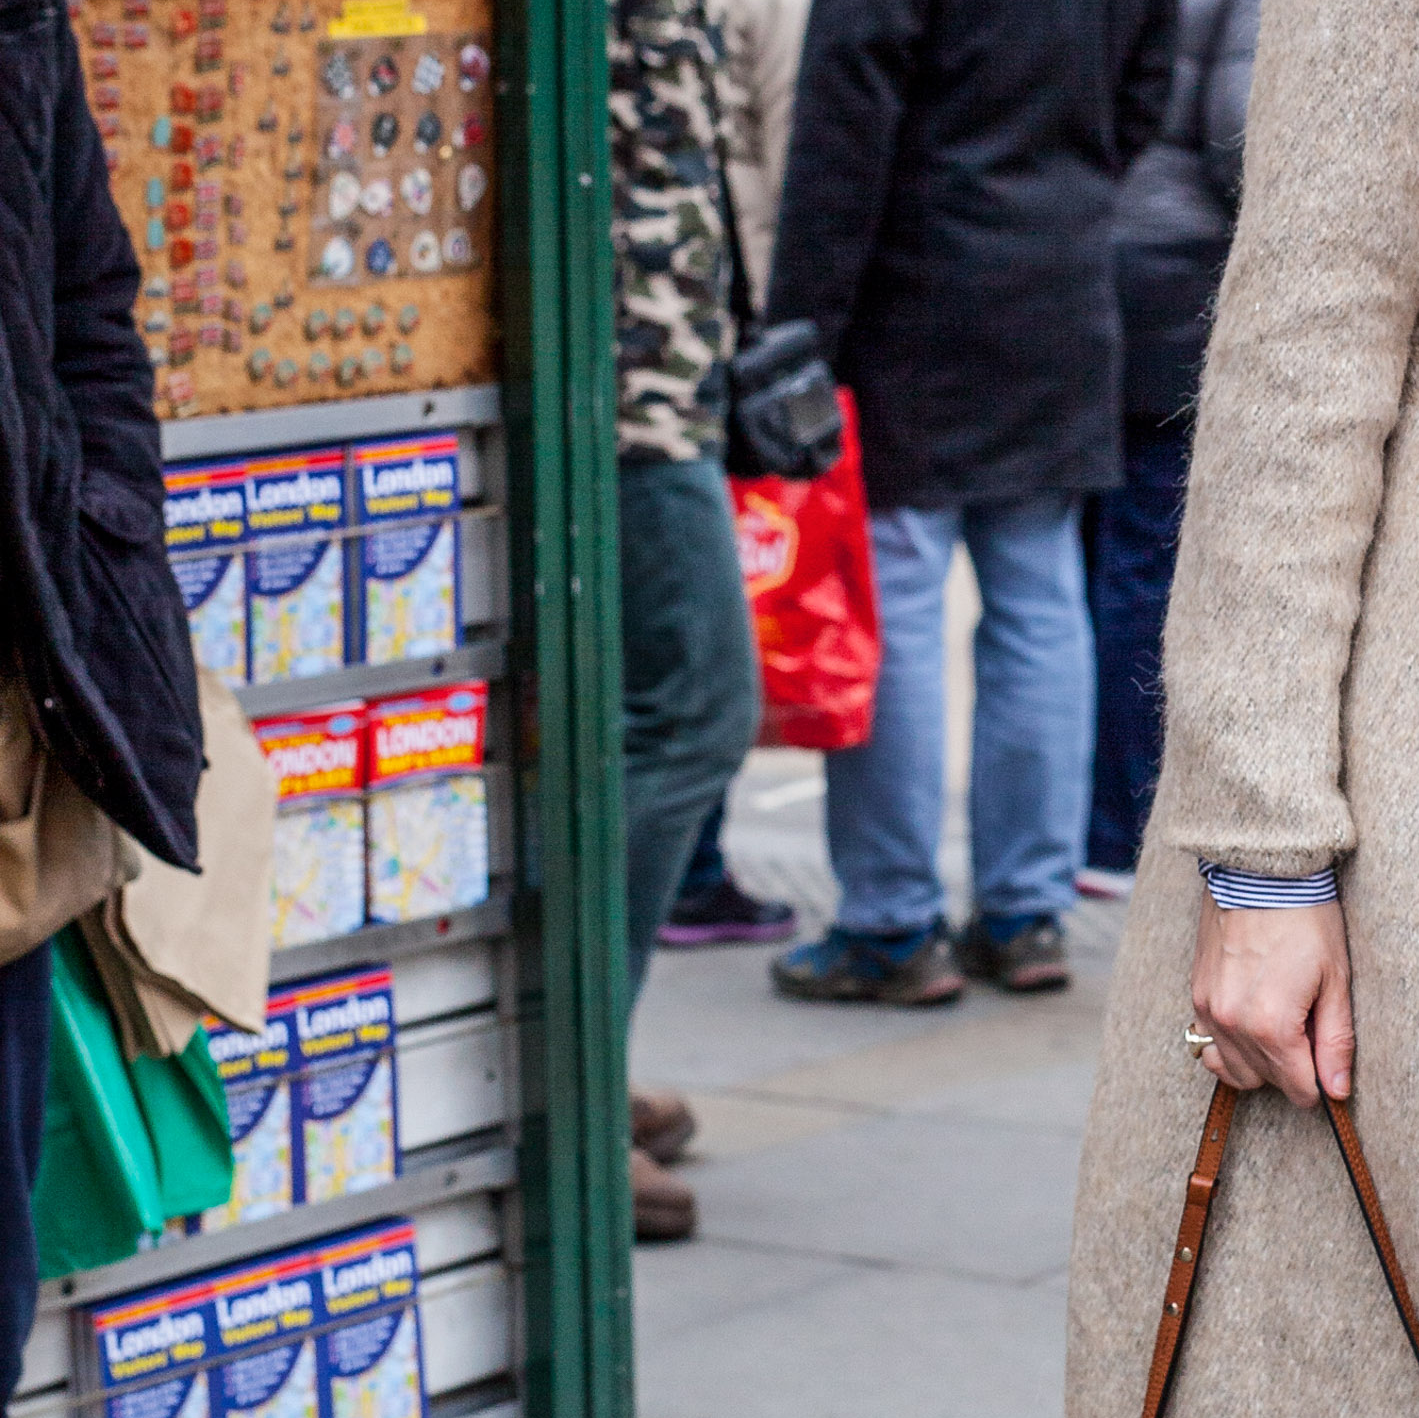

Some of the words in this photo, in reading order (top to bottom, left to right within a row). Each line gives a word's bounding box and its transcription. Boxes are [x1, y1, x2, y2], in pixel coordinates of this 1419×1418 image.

[244, 471, 341, 512] London
[362, 458, 454, 499] London
[162, 486, 244, 527] ondon
[375, 715, 479, 759] LONDON
[295, 995, 391, 1039] London
[321, 1251, 414, 1298] London
[215, 1280, 313, 1333] London
[104, 1311, 205, 1363] London
